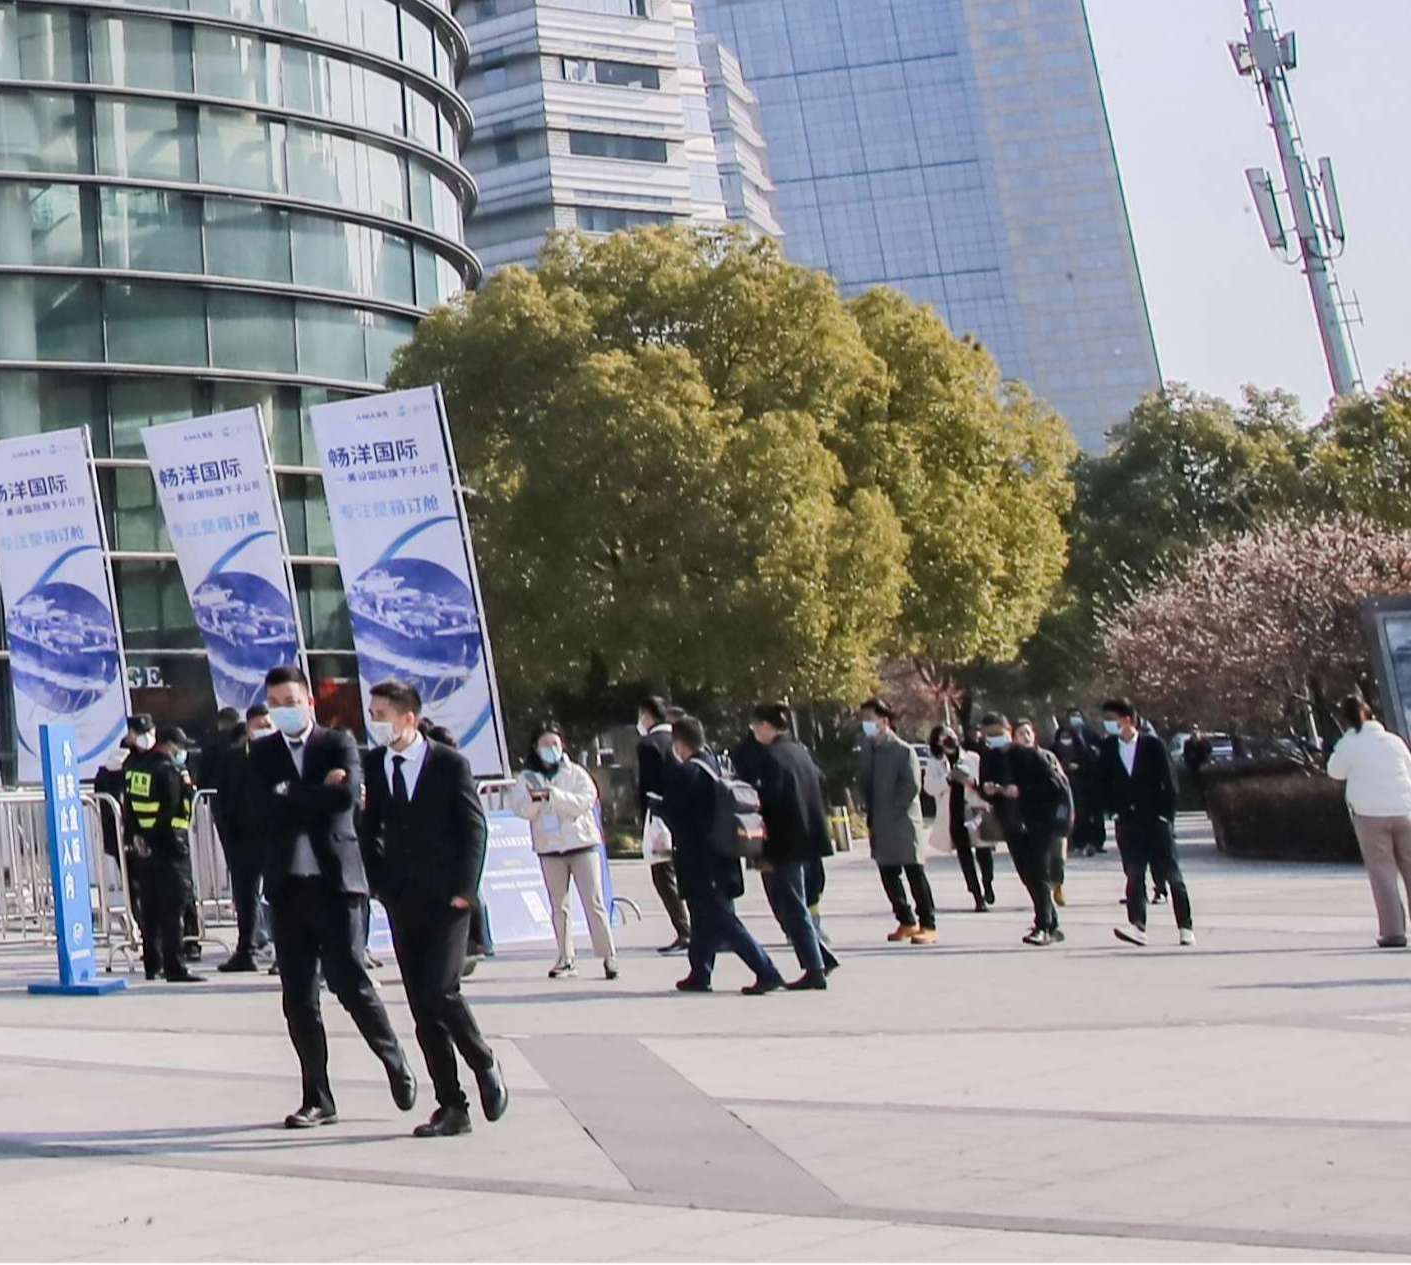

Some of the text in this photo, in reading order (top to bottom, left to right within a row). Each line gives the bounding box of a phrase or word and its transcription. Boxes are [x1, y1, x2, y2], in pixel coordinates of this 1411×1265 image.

[328, 439, 418, 468] 畅洋国际
[160, 458, 242, 488] 畅洋国际
